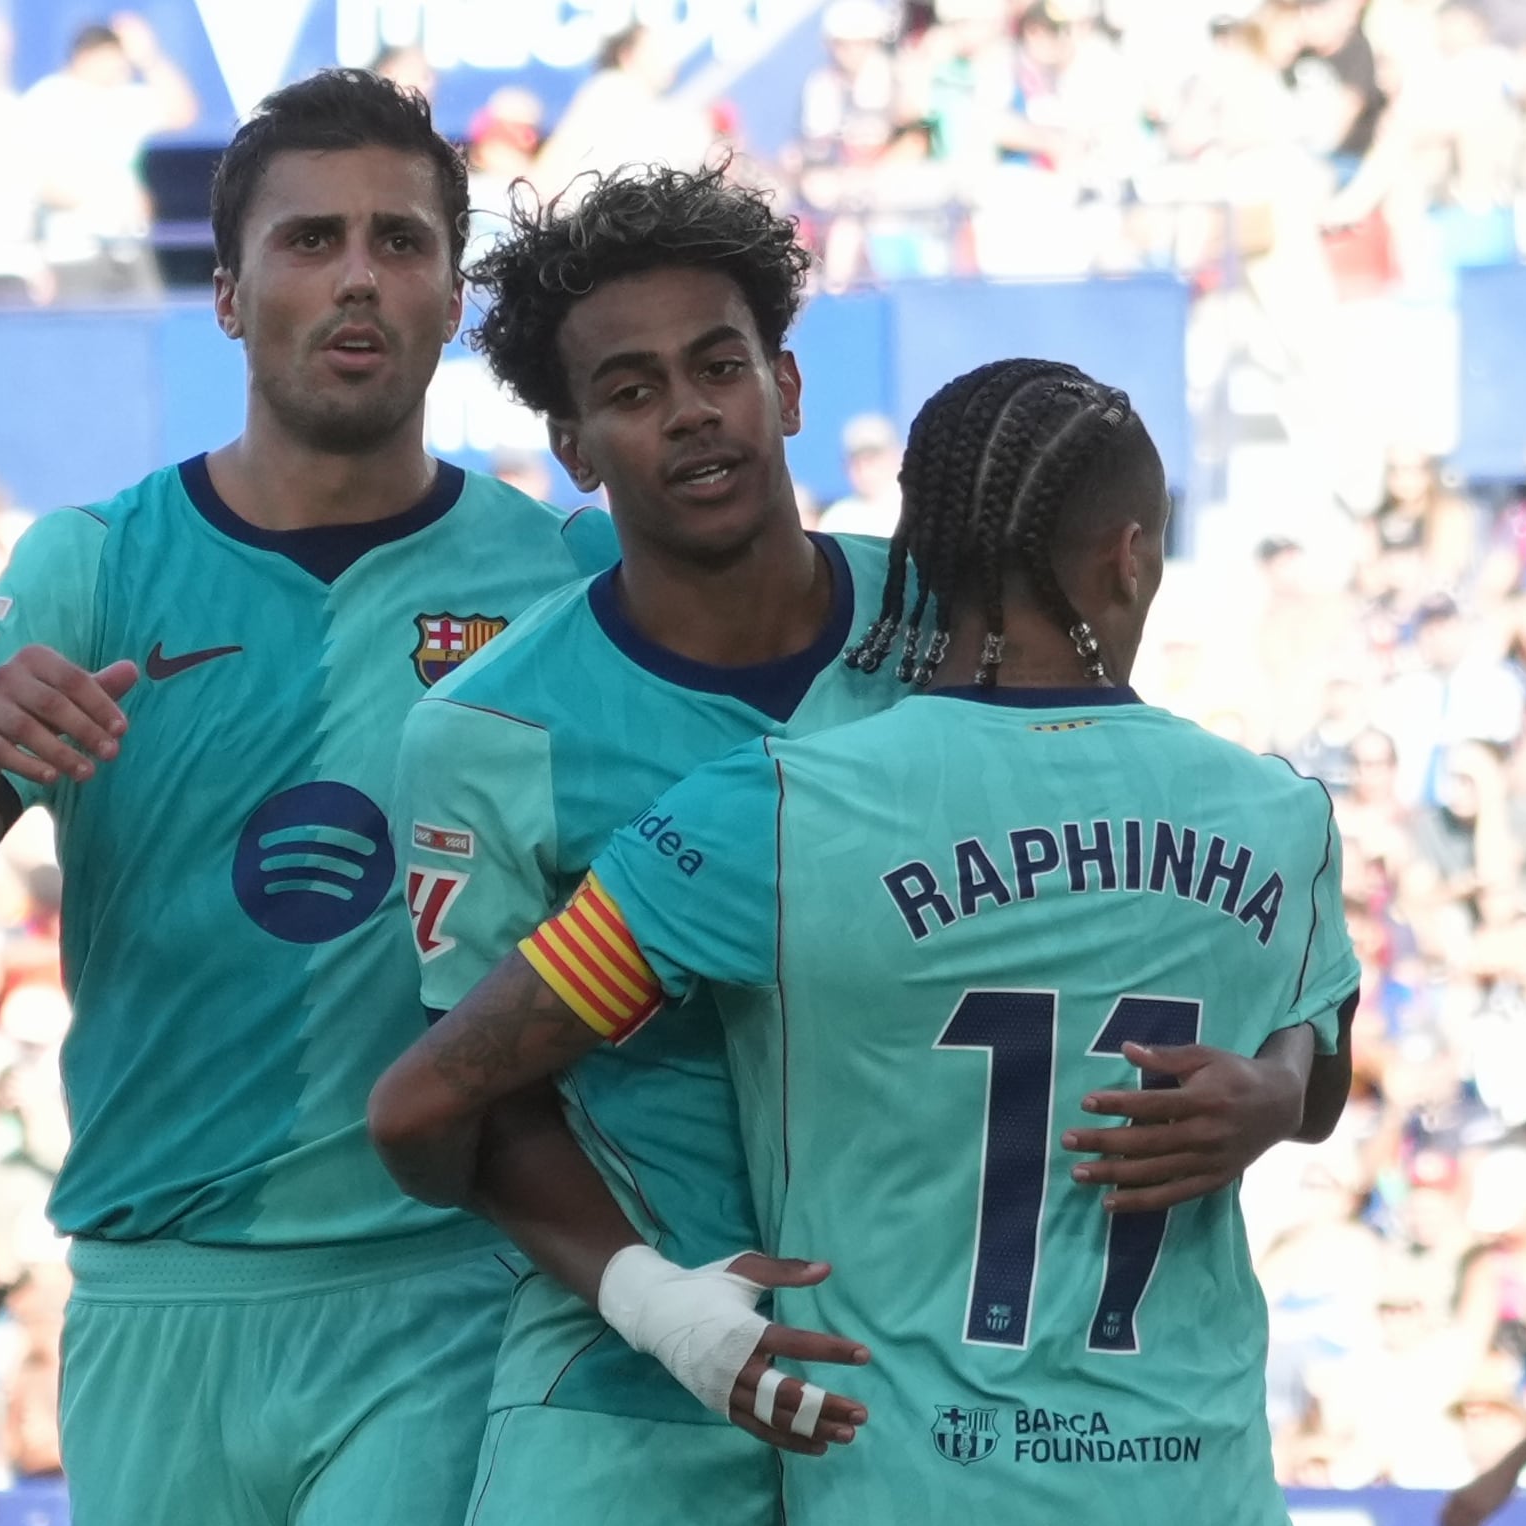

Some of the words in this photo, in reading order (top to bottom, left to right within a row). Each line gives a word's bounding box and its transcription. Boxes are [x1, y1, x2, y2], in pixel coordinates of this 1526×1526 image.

[880, 819, 1286, 949] RAPHINHA
[931, 988, 1204, 1356] 11
[1014, 1407, 1110, 1438] BARÇA
[1014, 1436, 1202, 1463] FOUNDATION
